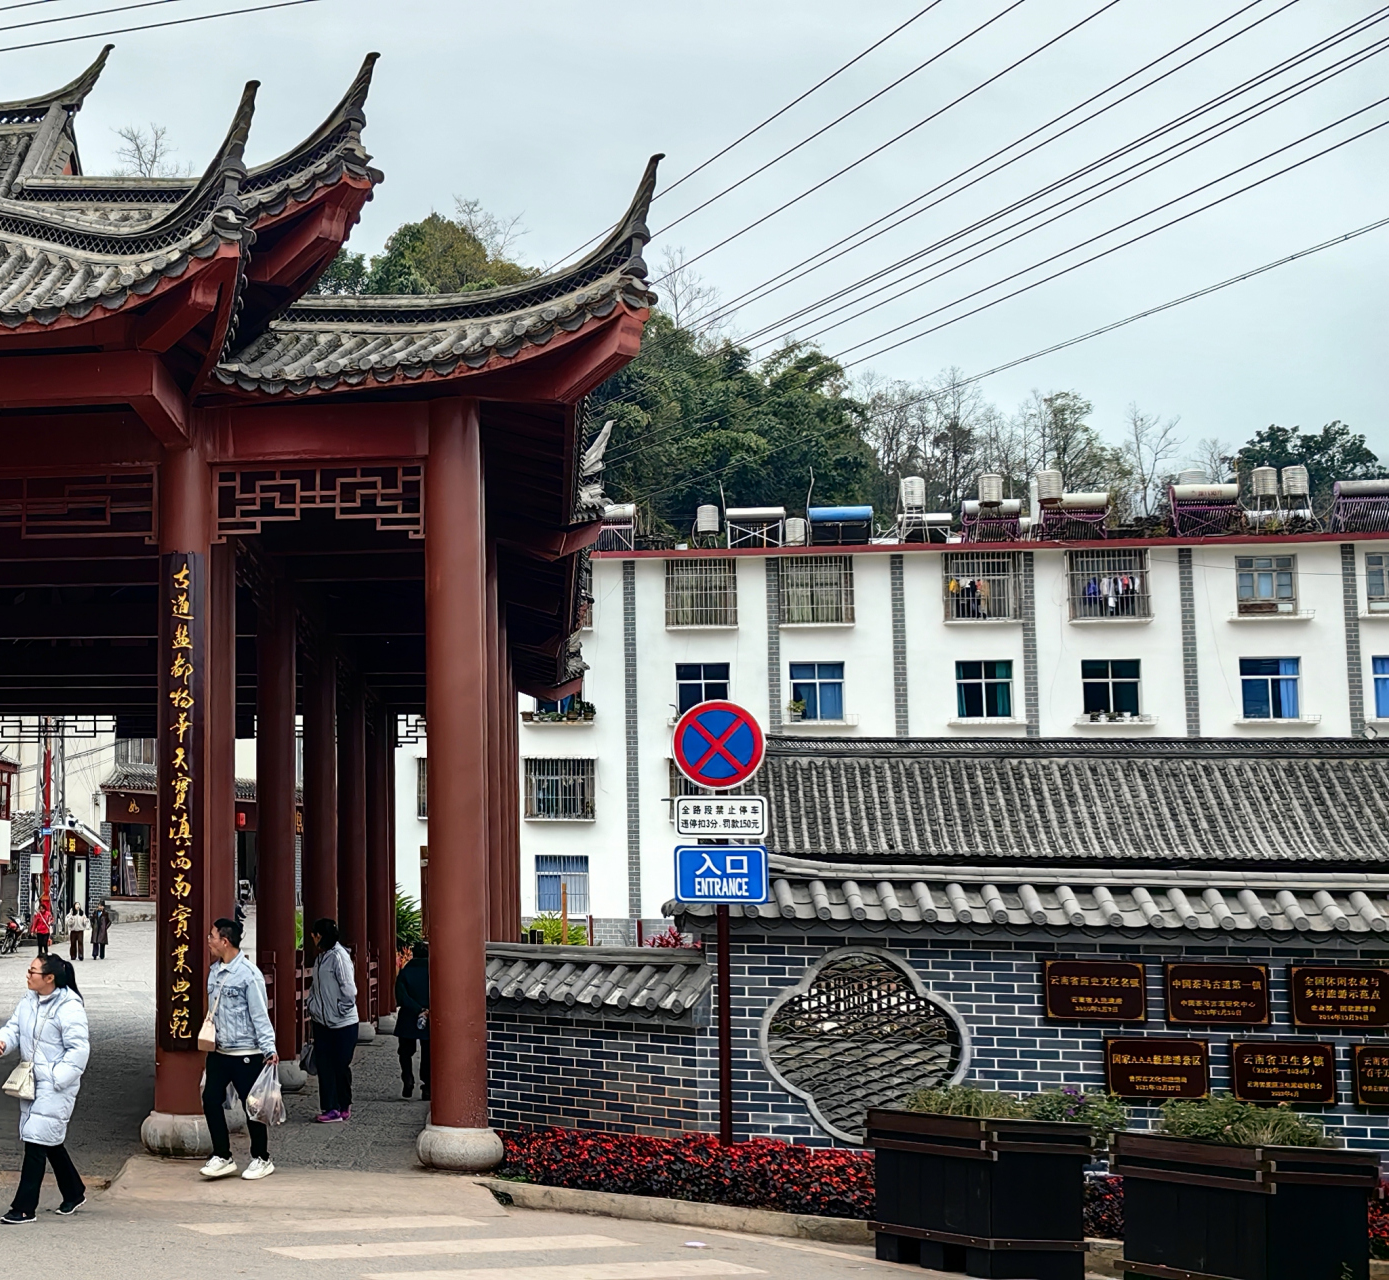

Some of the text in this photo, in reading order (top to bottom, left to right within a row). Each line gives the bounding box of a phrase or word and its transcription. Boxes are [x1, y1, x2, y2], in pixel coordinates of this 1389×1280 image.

[681, 805, 759, 815] 全路段禁止停车
[695, 853, 748, 875] 入口
[695, 878, 749, 896] ENTRANCE
[1242, 1054, 1325, 1067] 云南省卫生乡镇
